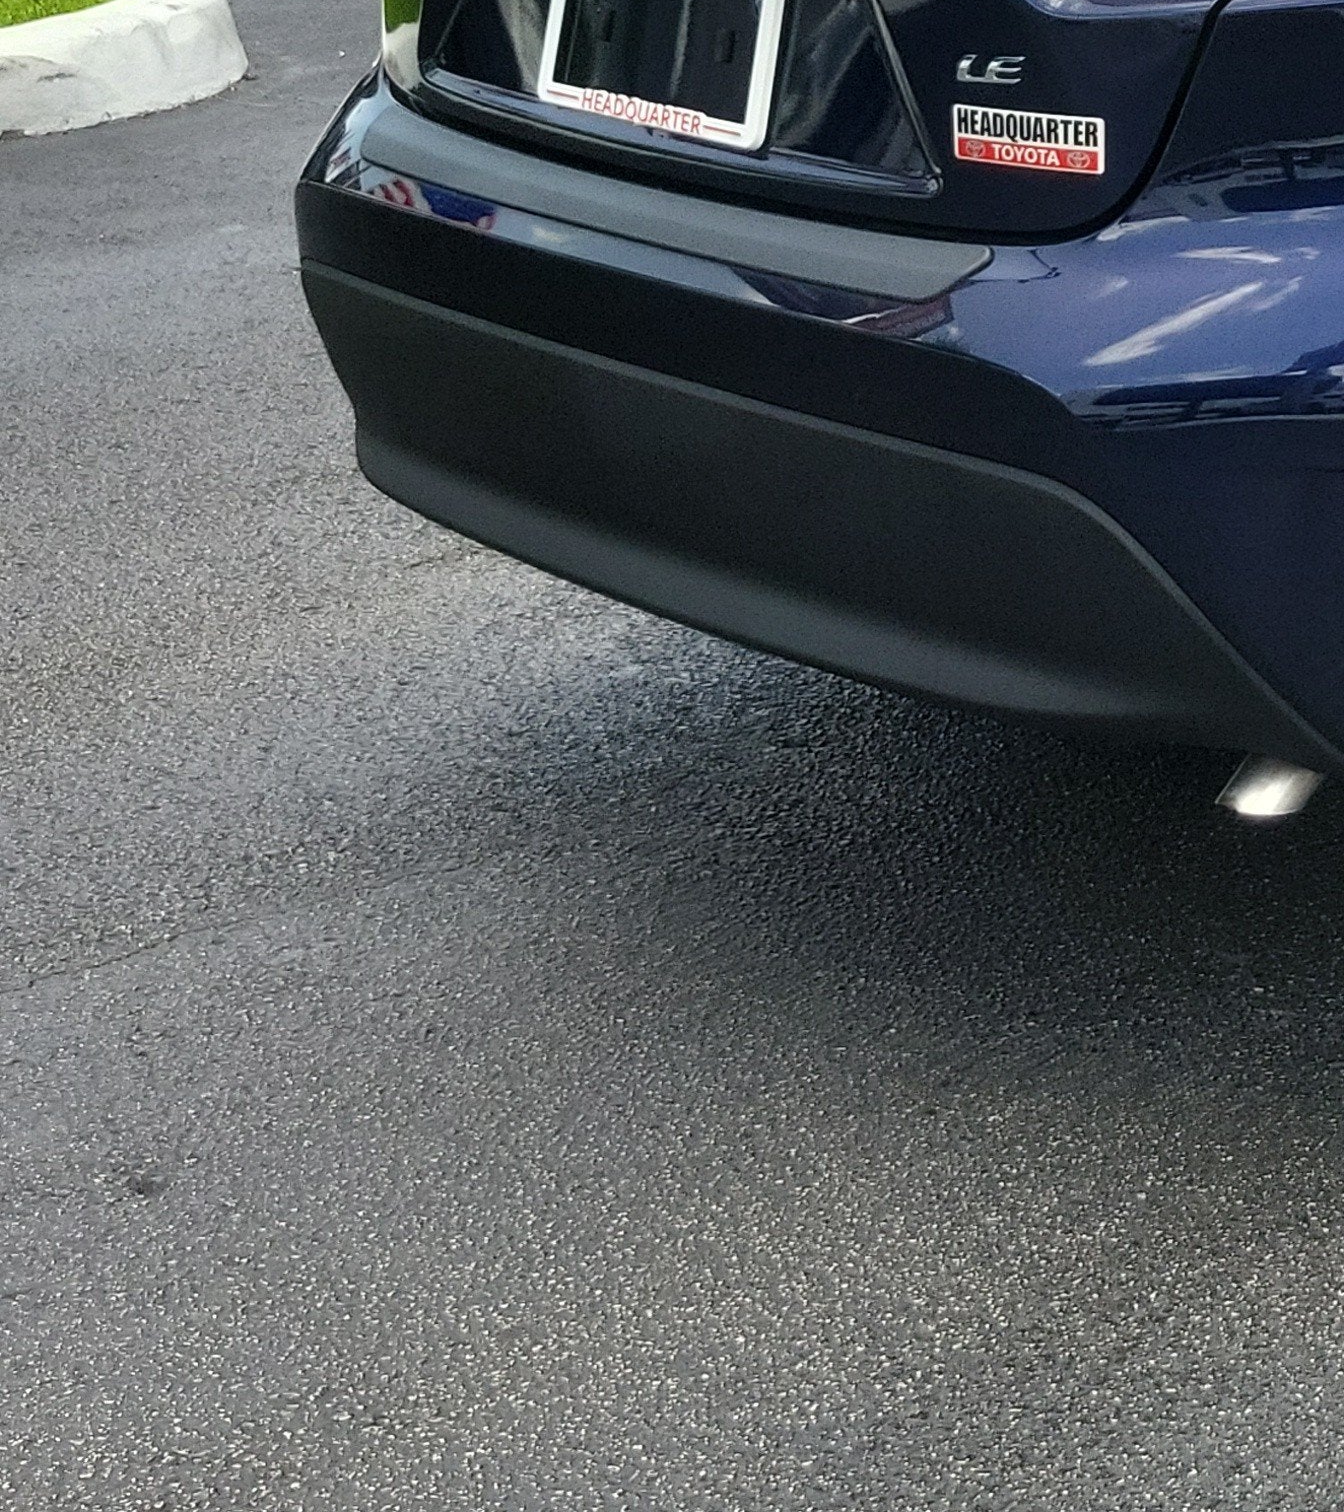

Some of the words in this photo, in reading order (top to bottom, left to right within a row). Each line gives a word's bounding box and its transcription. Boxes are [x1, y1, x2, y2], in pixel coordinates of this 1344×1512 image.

[956, 54, 1026, 85] LE
[581, 88, 701, 134] HEADQUARTER
[956, 106, 1099, 148] HEADQUARTER
[990, 143, 1060, 167] TOYOTA
